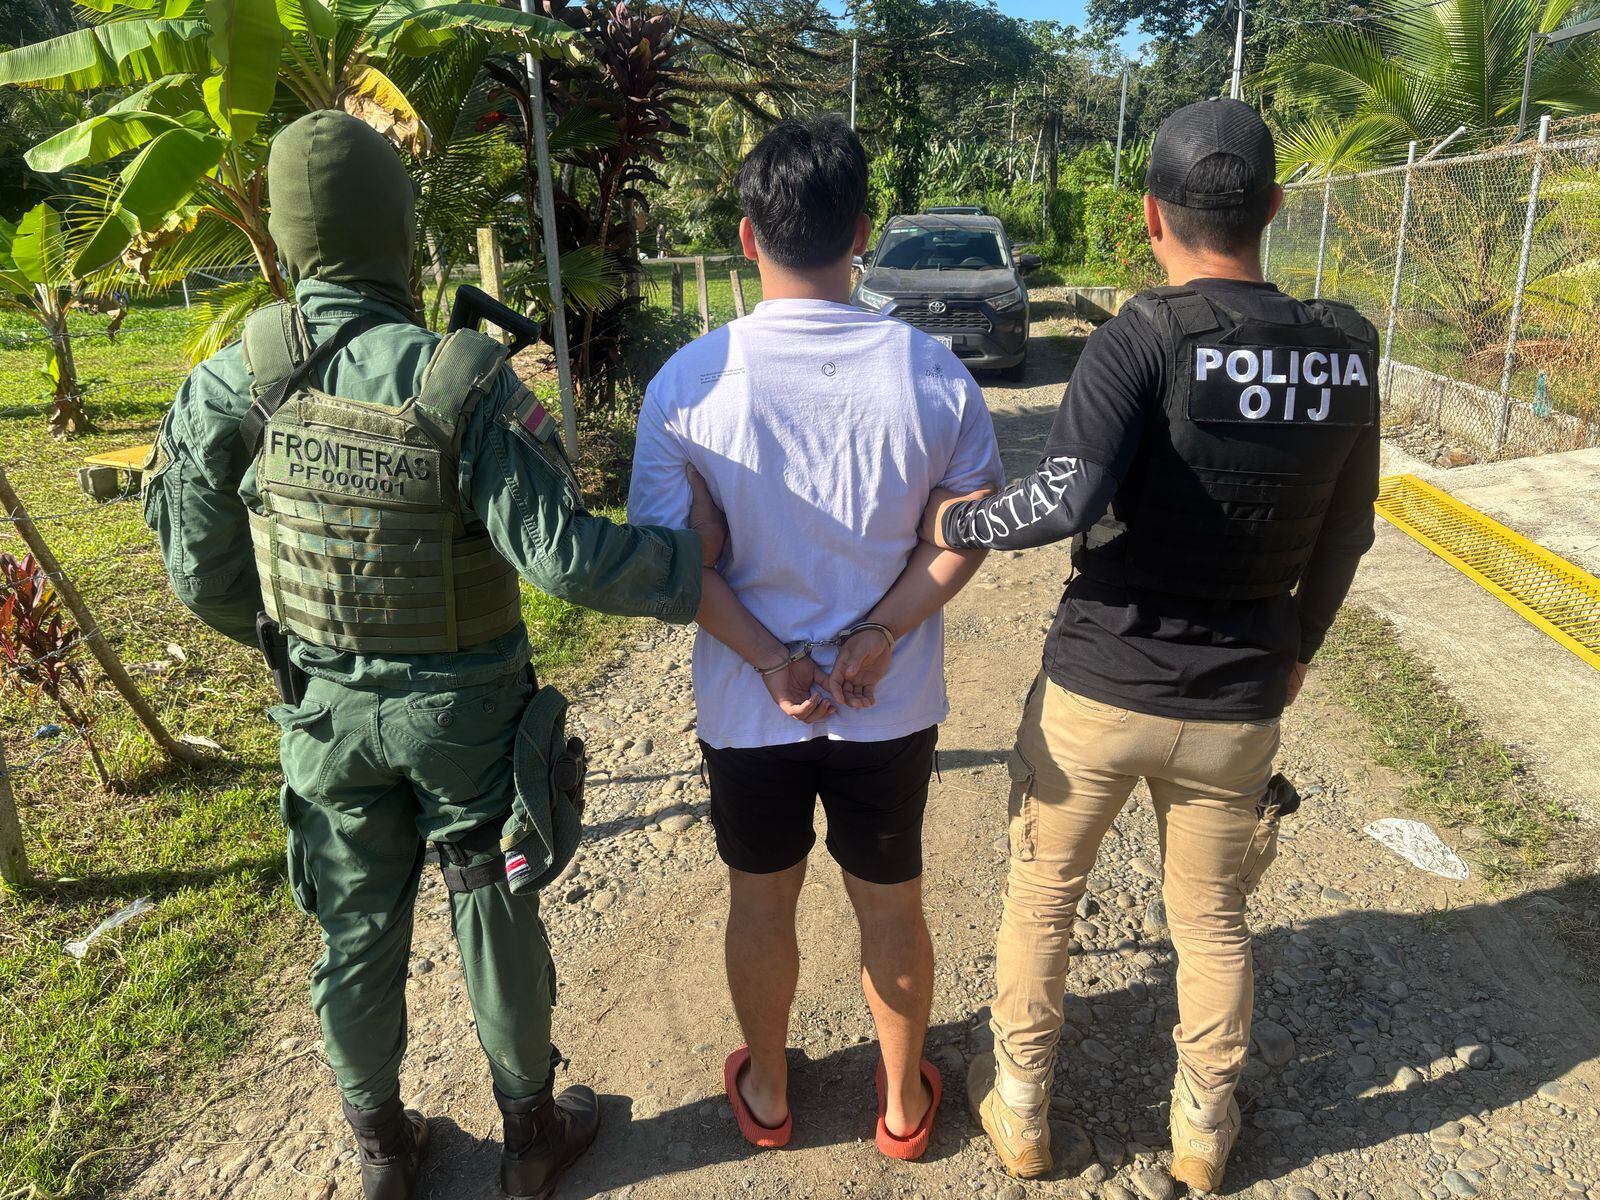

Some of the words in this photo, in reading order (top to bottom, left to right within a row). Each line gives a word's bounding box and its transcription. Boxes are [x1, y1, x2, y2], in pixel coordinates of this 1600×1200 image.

[1196, 348, 1369, 386] POLICIA
[270, 430, 430, 481] FRONTERAS
[288, 463, 405, 496] PF000001
